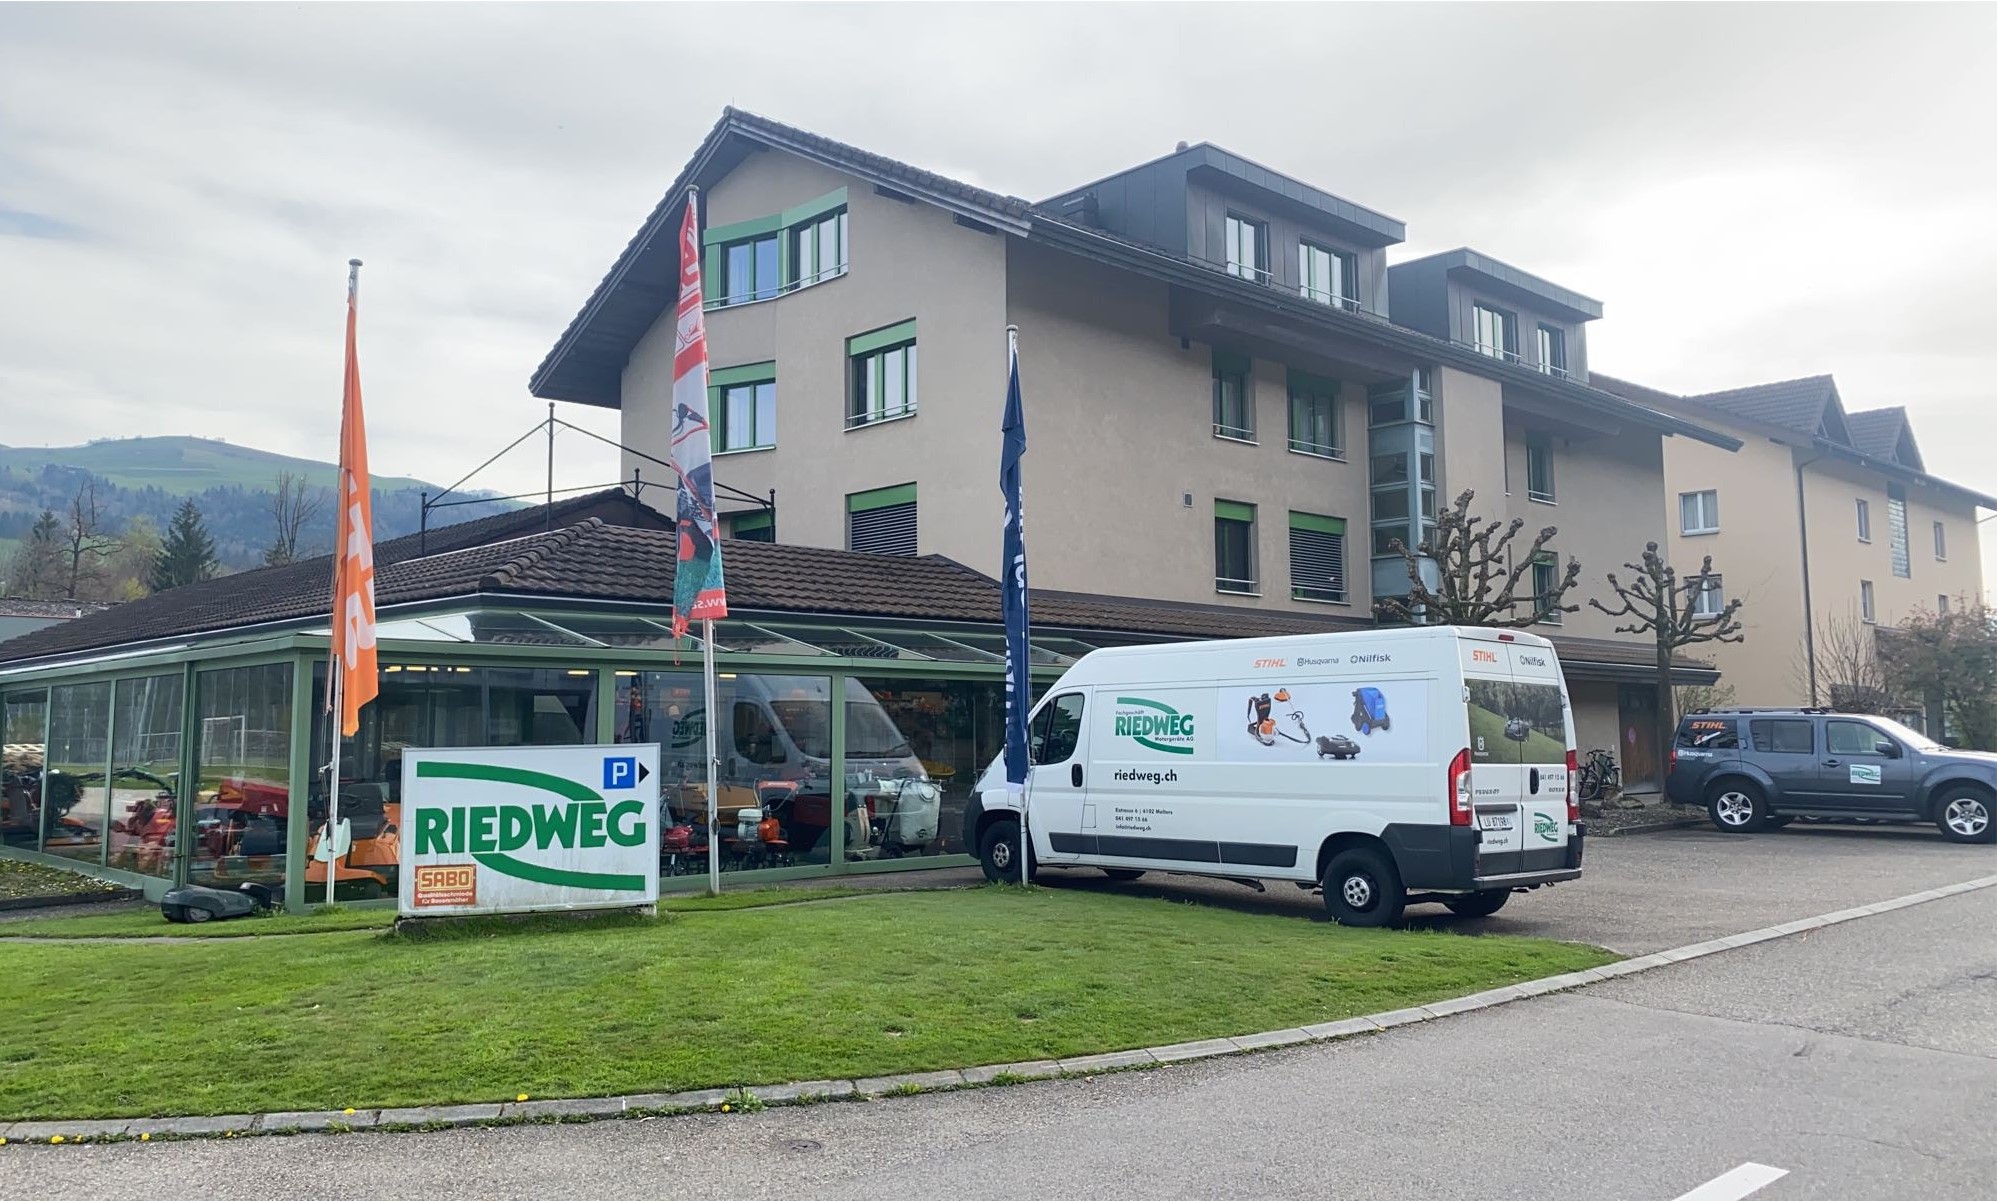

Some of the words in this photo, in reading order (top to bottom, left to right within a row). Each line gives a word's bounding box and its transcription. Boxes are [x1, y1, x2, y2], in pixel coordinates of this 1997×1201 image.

[1304, 657, 1340, 666] Husqvarna
[1358, 654, 1391, 663] Nilfisk
[1472, 650, 1498, 663] STIHL
[1253, 658, 1286, 669] STIHL
[1115, 714, 1195, 736] RIEDWEG
[1691, 721, 1726, 730] STIHL
[612, 762, 628, 785] P
[1114, 768, 1178, 785] riedweg.ch
[415, 800, 646, 855] RIEDWEG
[1534, 822, 1558, 834] RIEDWEG
[421, 871, 470, 888] SABO
